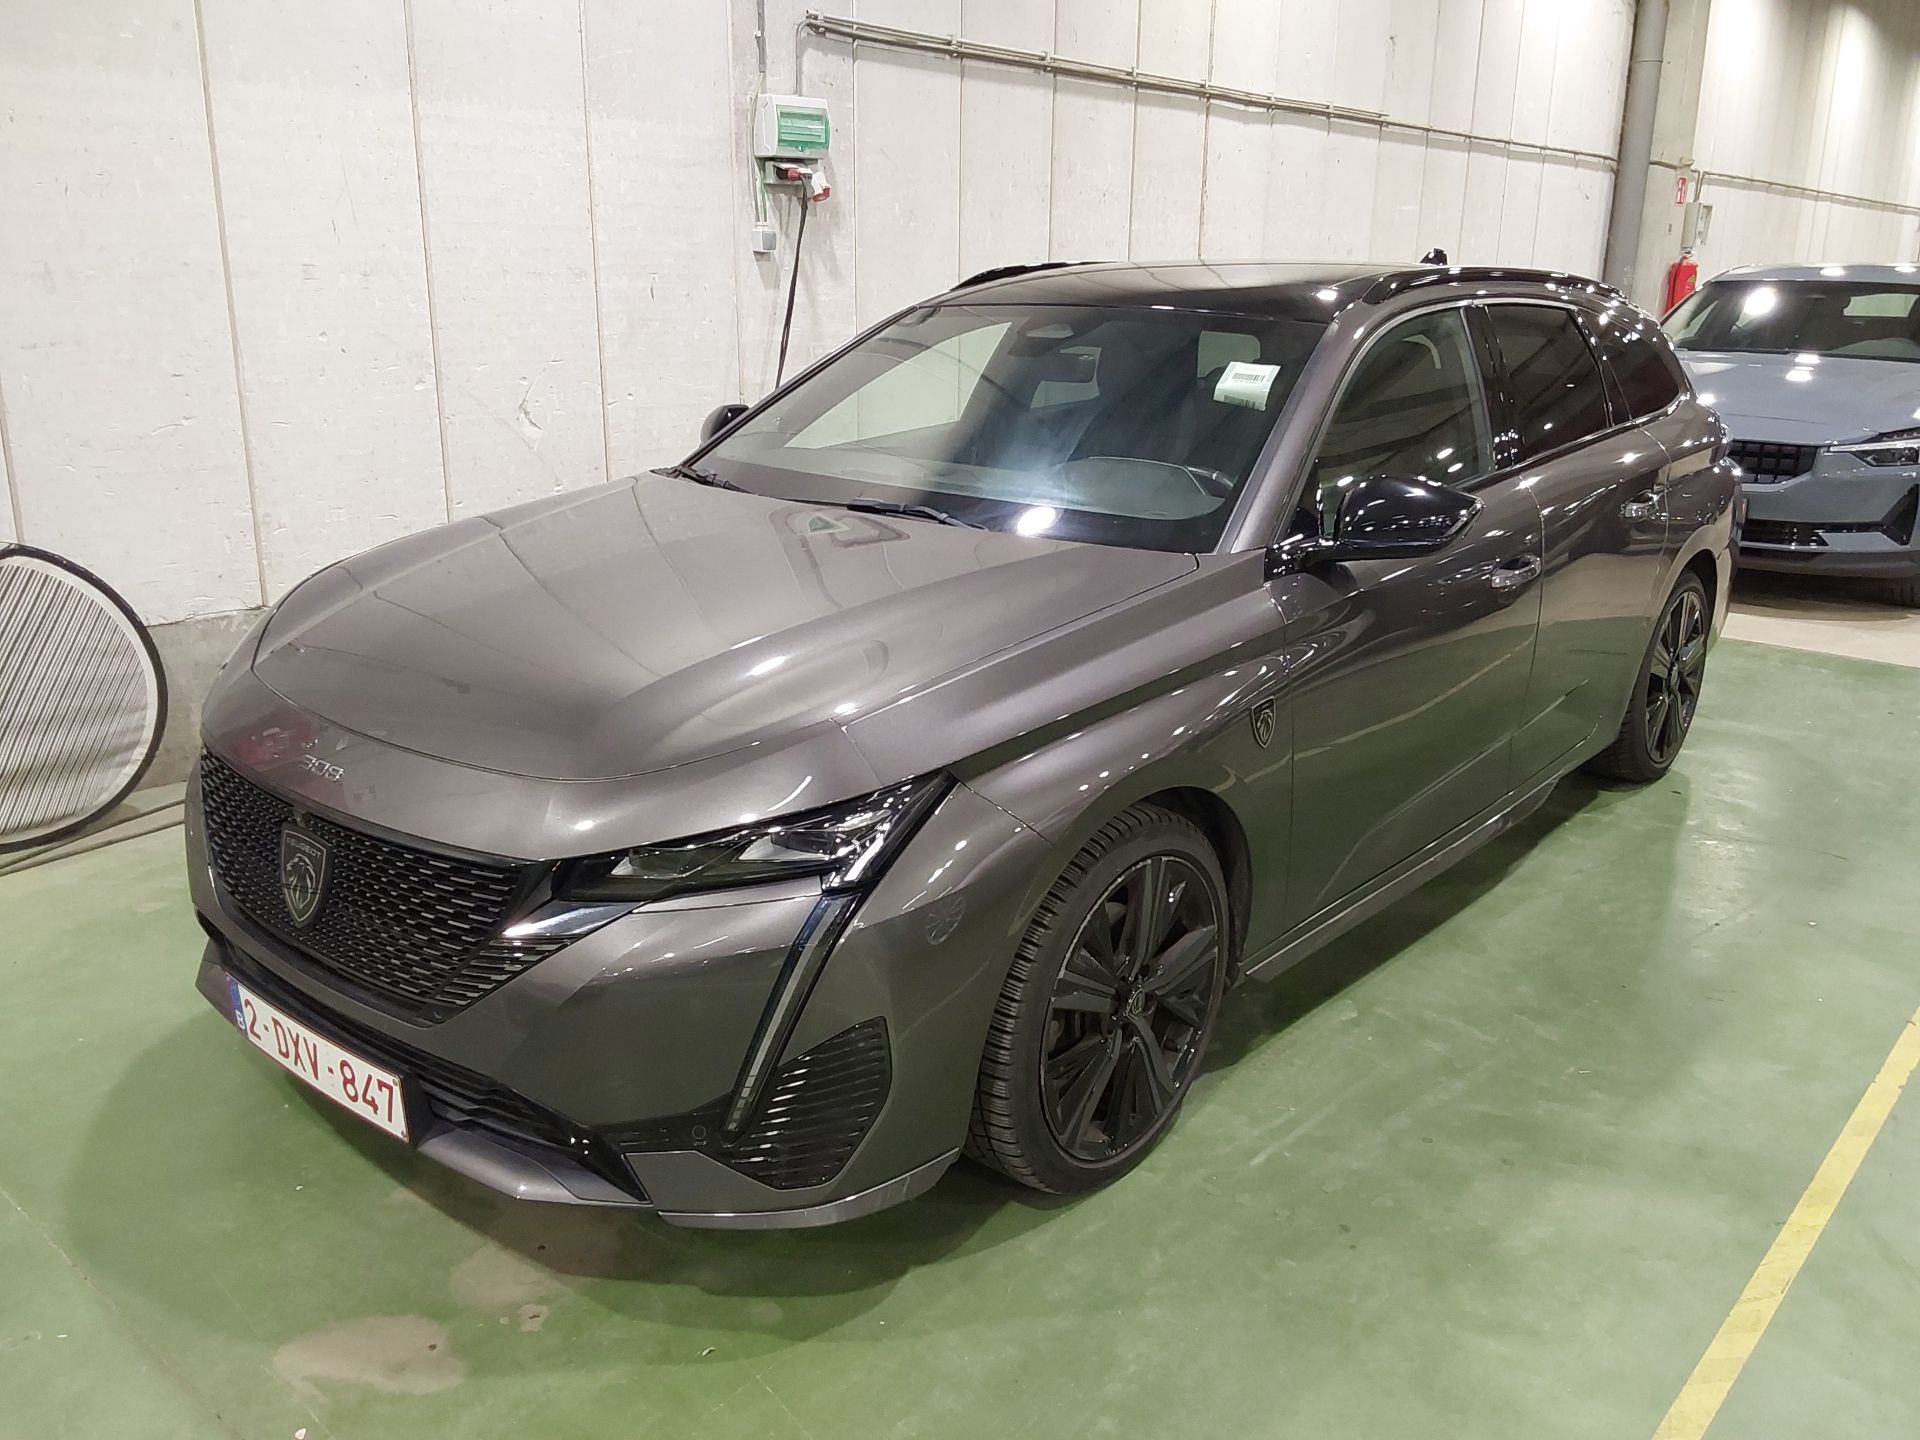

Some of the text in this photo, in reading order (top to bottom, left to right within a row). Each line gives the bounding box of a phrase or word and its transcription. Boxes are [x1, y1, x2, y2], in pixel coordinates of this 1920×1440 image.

[299, 754, 345, 782] 308
[235, 1009, 246, 1030] B
[244, 998, 394, 1123] 2-DXV-847
